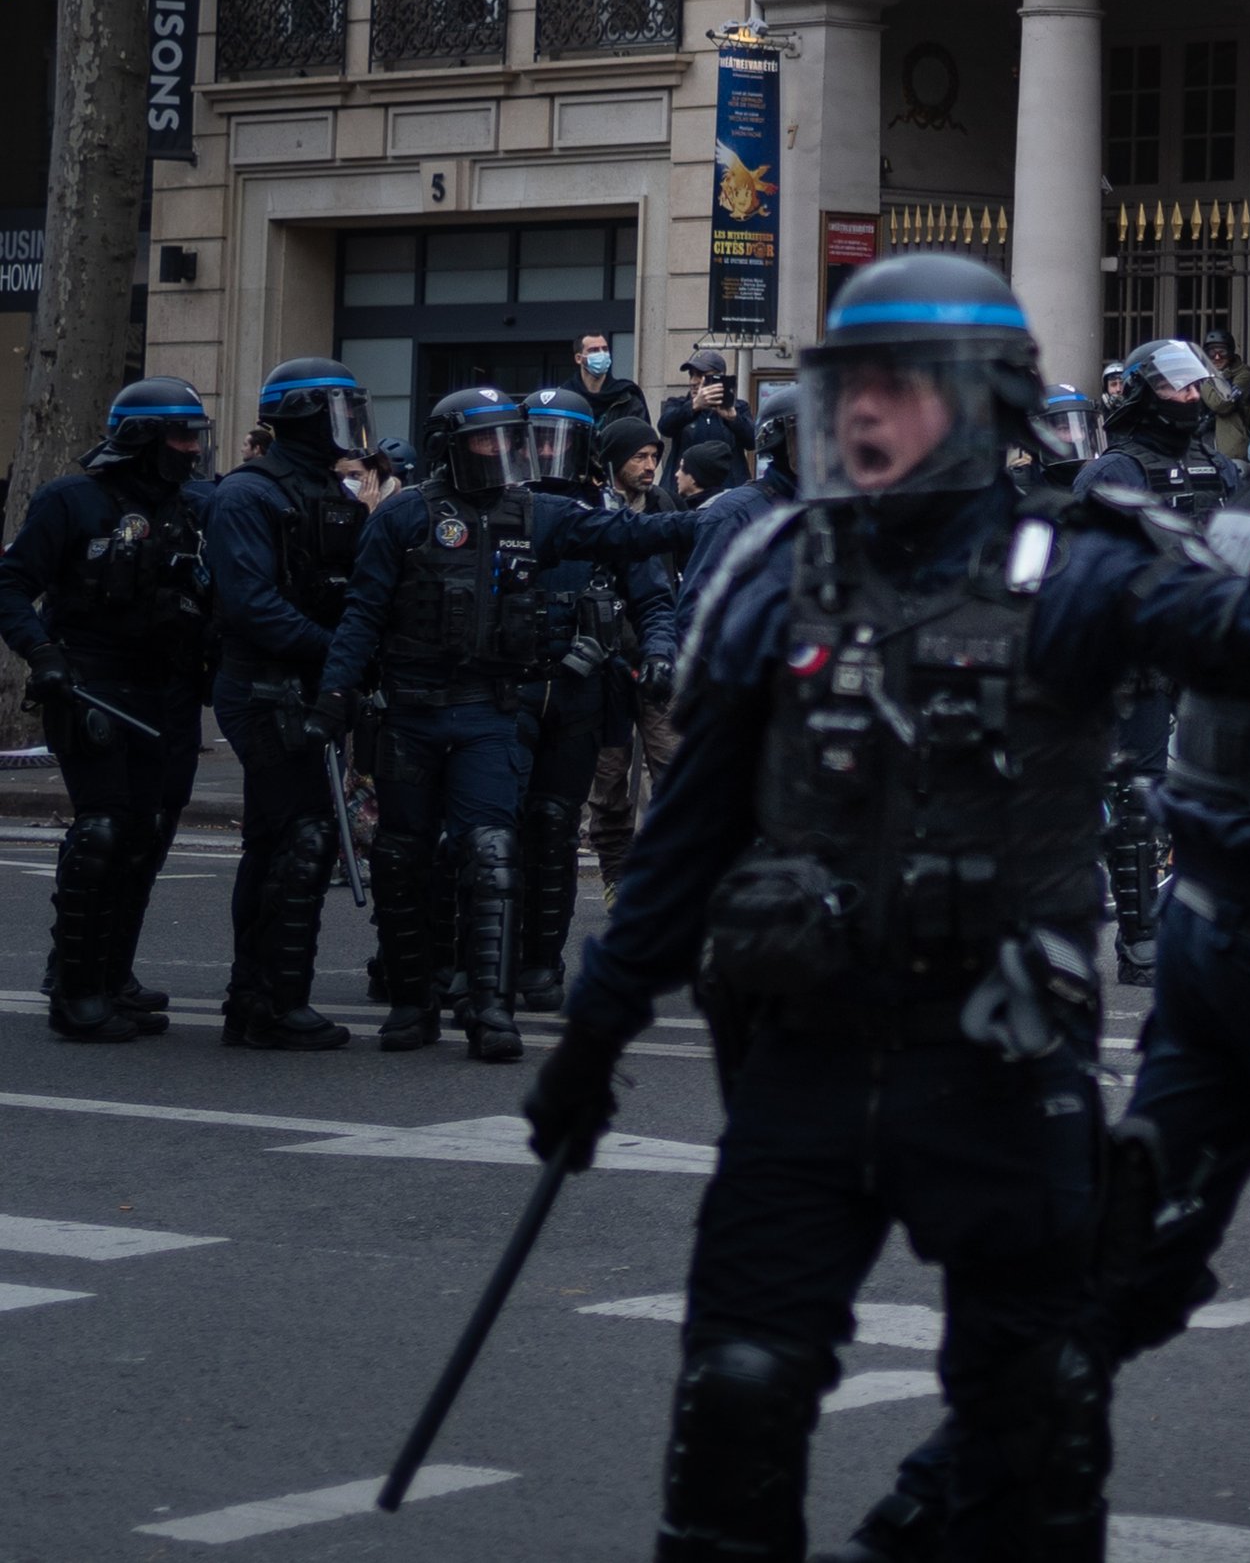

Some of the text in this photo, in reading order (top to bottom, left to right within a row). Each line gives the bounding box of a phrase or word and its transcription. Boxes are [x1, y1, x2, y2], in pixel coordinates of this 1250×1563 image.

[431, 172, 446, 203] 5
[713, 240, 745, 255] CITÉS
[499, 539, 531, 549] POLICE
